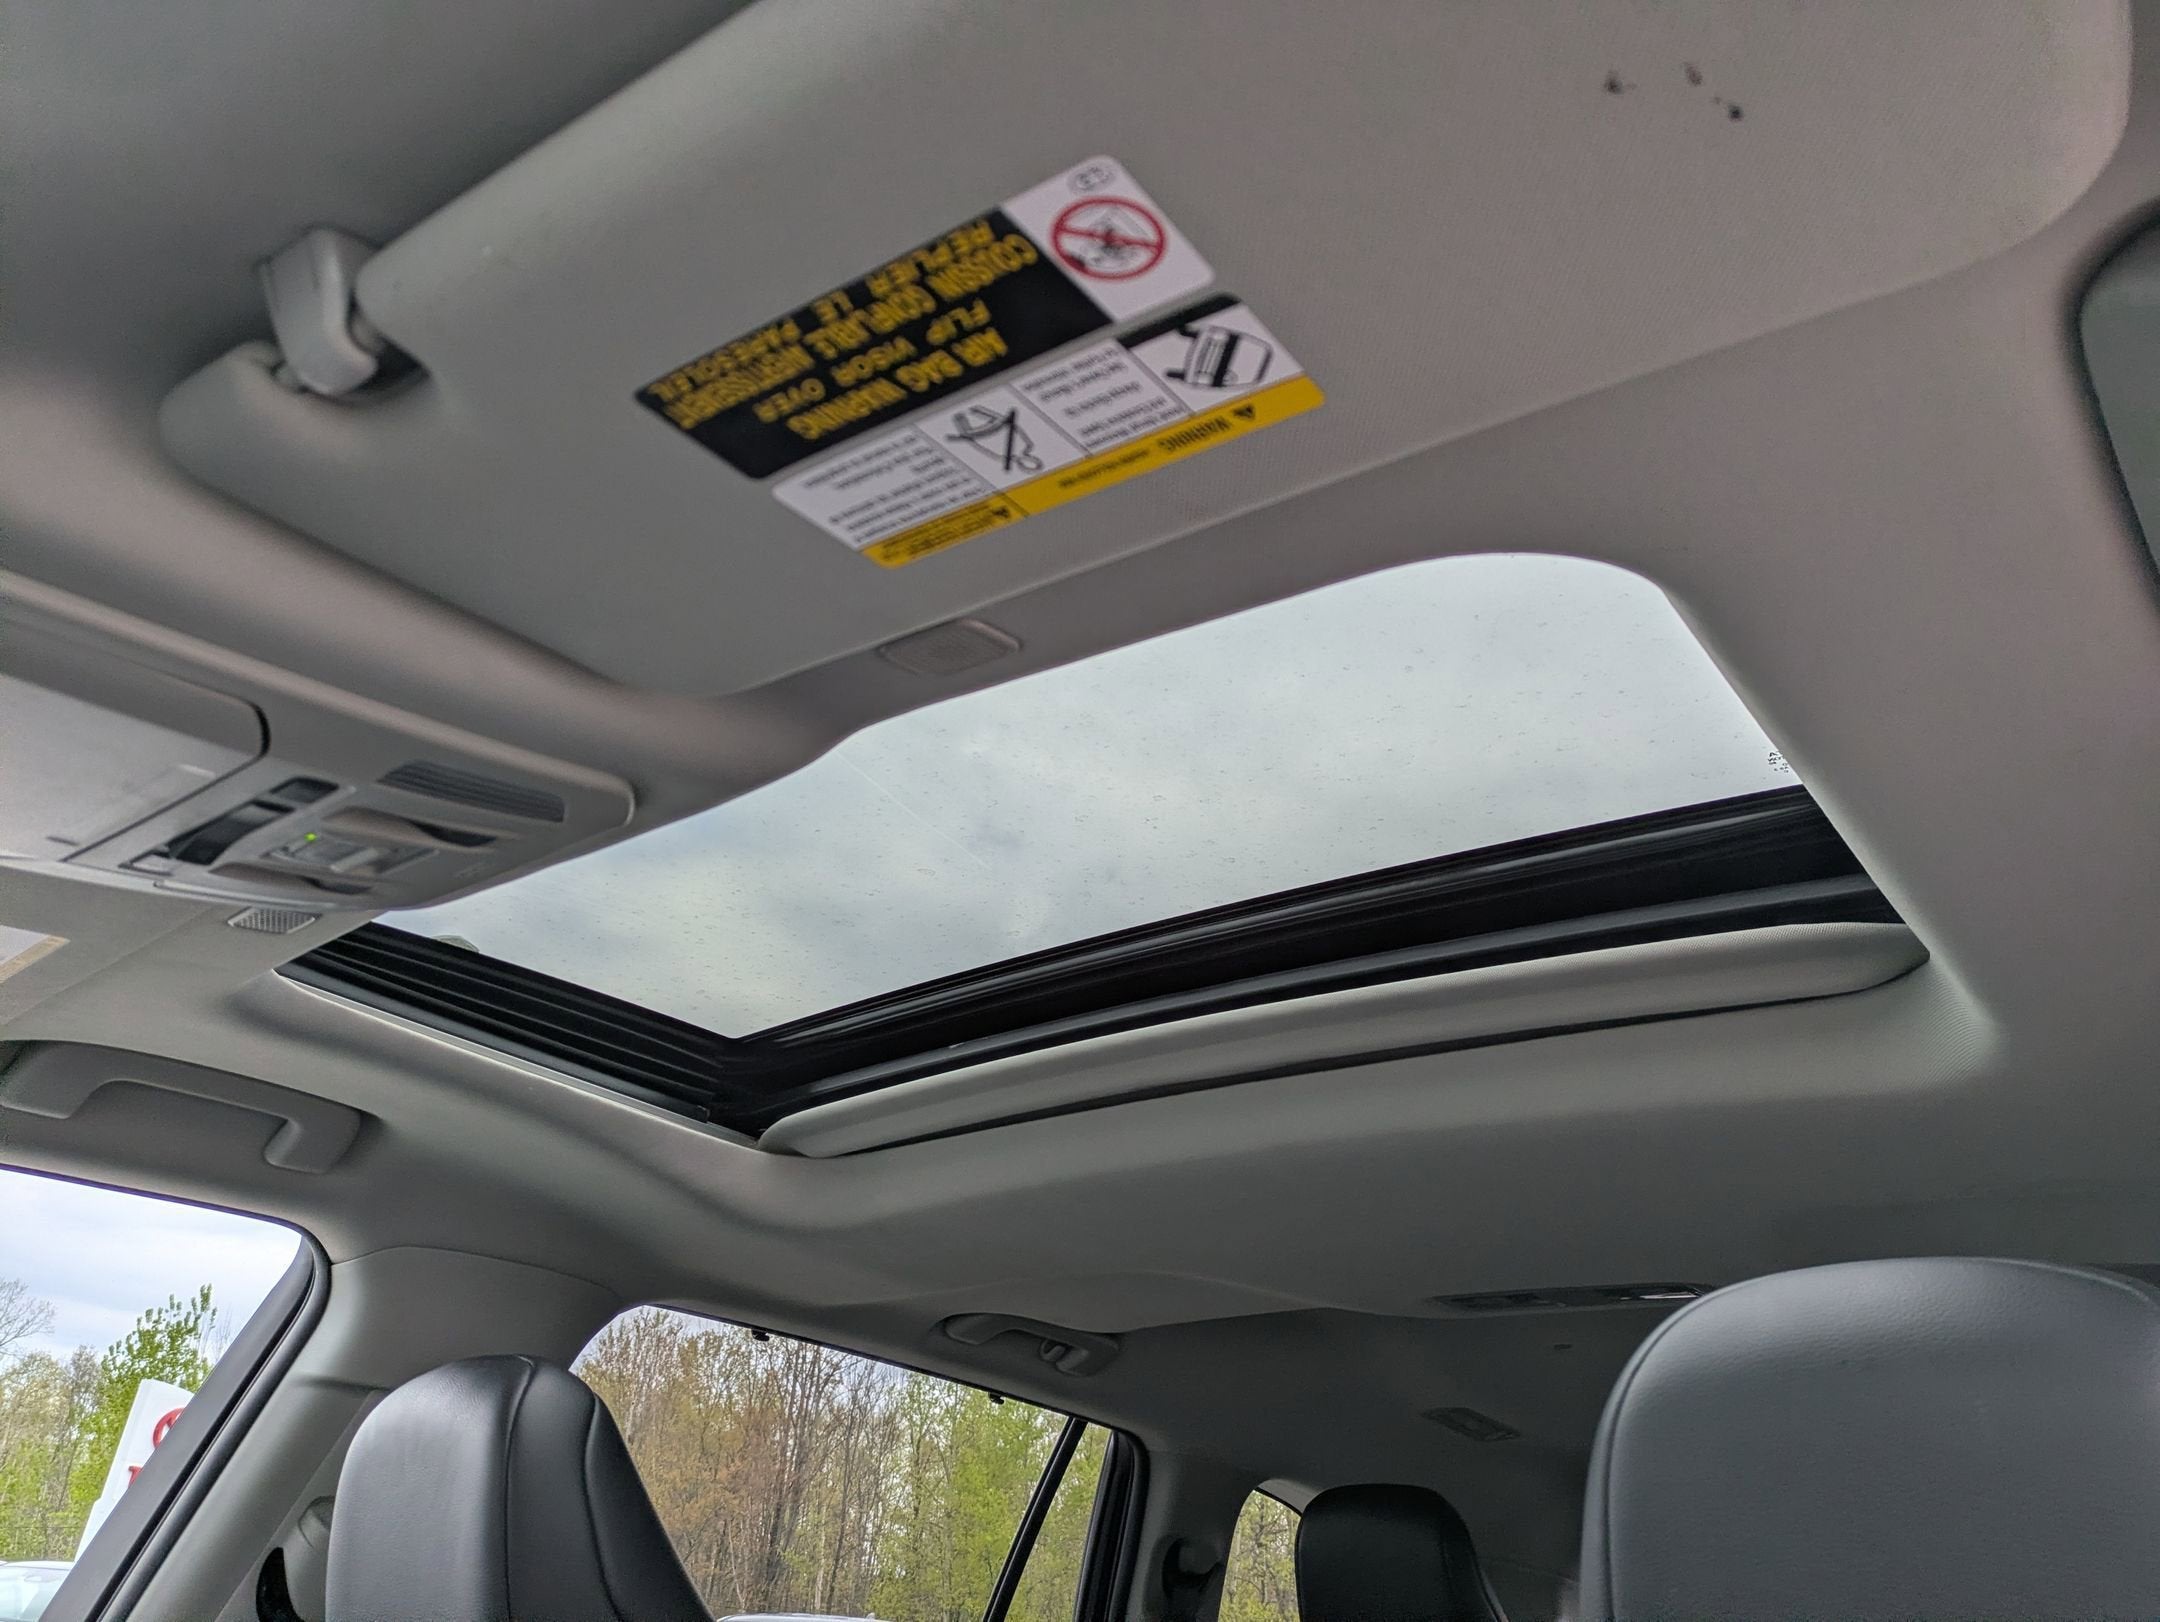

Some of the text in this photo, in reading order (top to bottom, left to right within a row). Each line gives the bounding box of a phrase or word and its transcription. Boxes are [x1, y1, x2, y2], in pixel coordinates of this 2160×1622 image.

[925, 233, 1040, 300] COUSSIN
[807, 287, 856, 325] LE
[754, 298, 992, 423] FLIP VISOR OVER
[785, 327, 1010, 441] AIR BAG WARNING
[1155, 414, 1235, 454] WARNING
